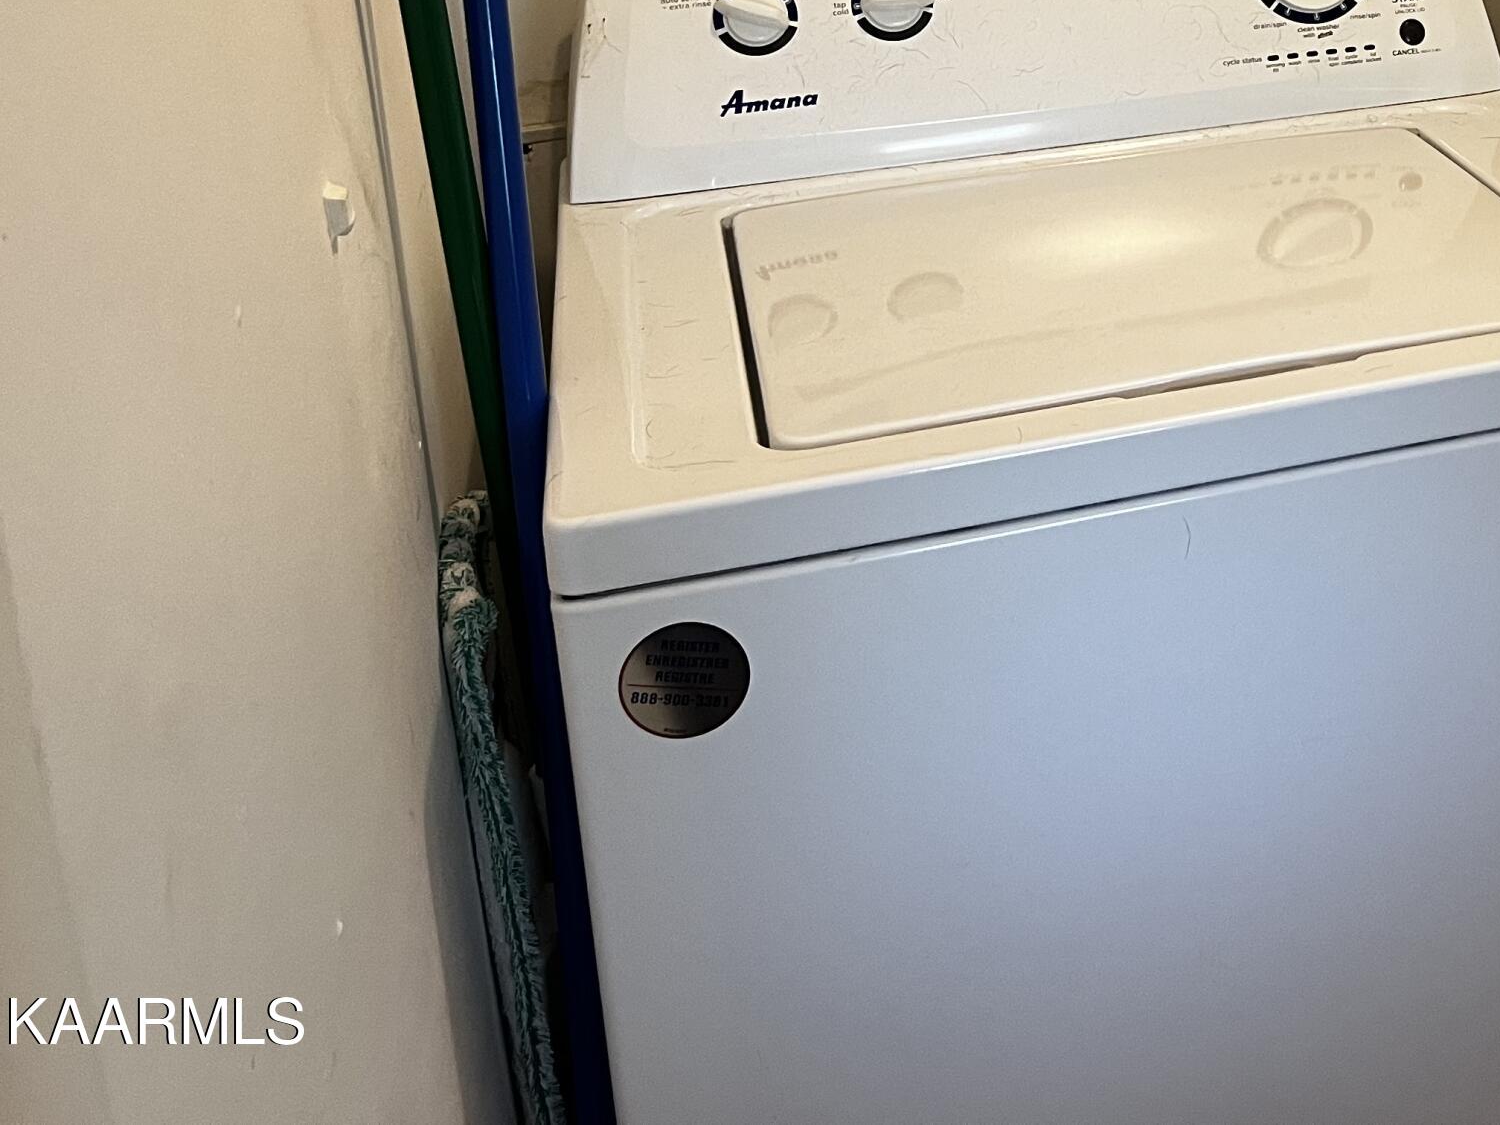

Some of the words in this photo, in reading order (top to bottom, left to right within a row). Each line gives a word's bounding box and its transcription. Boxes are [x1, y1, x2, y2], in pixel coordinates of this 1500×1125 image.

[834, 2, 846, 10] tap
[1350, 12, 1381, 20] rinse/spin
[1253, 21, 1287, 30] drain/spin
[1392, 48, 1420, 56] CANCEL
[1222, 59, 1240, 67] cycle
[720, 89, 819, 117] Amana
[660, 639, 720, 653] REGISTER
[645, 655, 730, 668] ENREGISTRER
[630, 691, 729, 708] 888-900-3381
